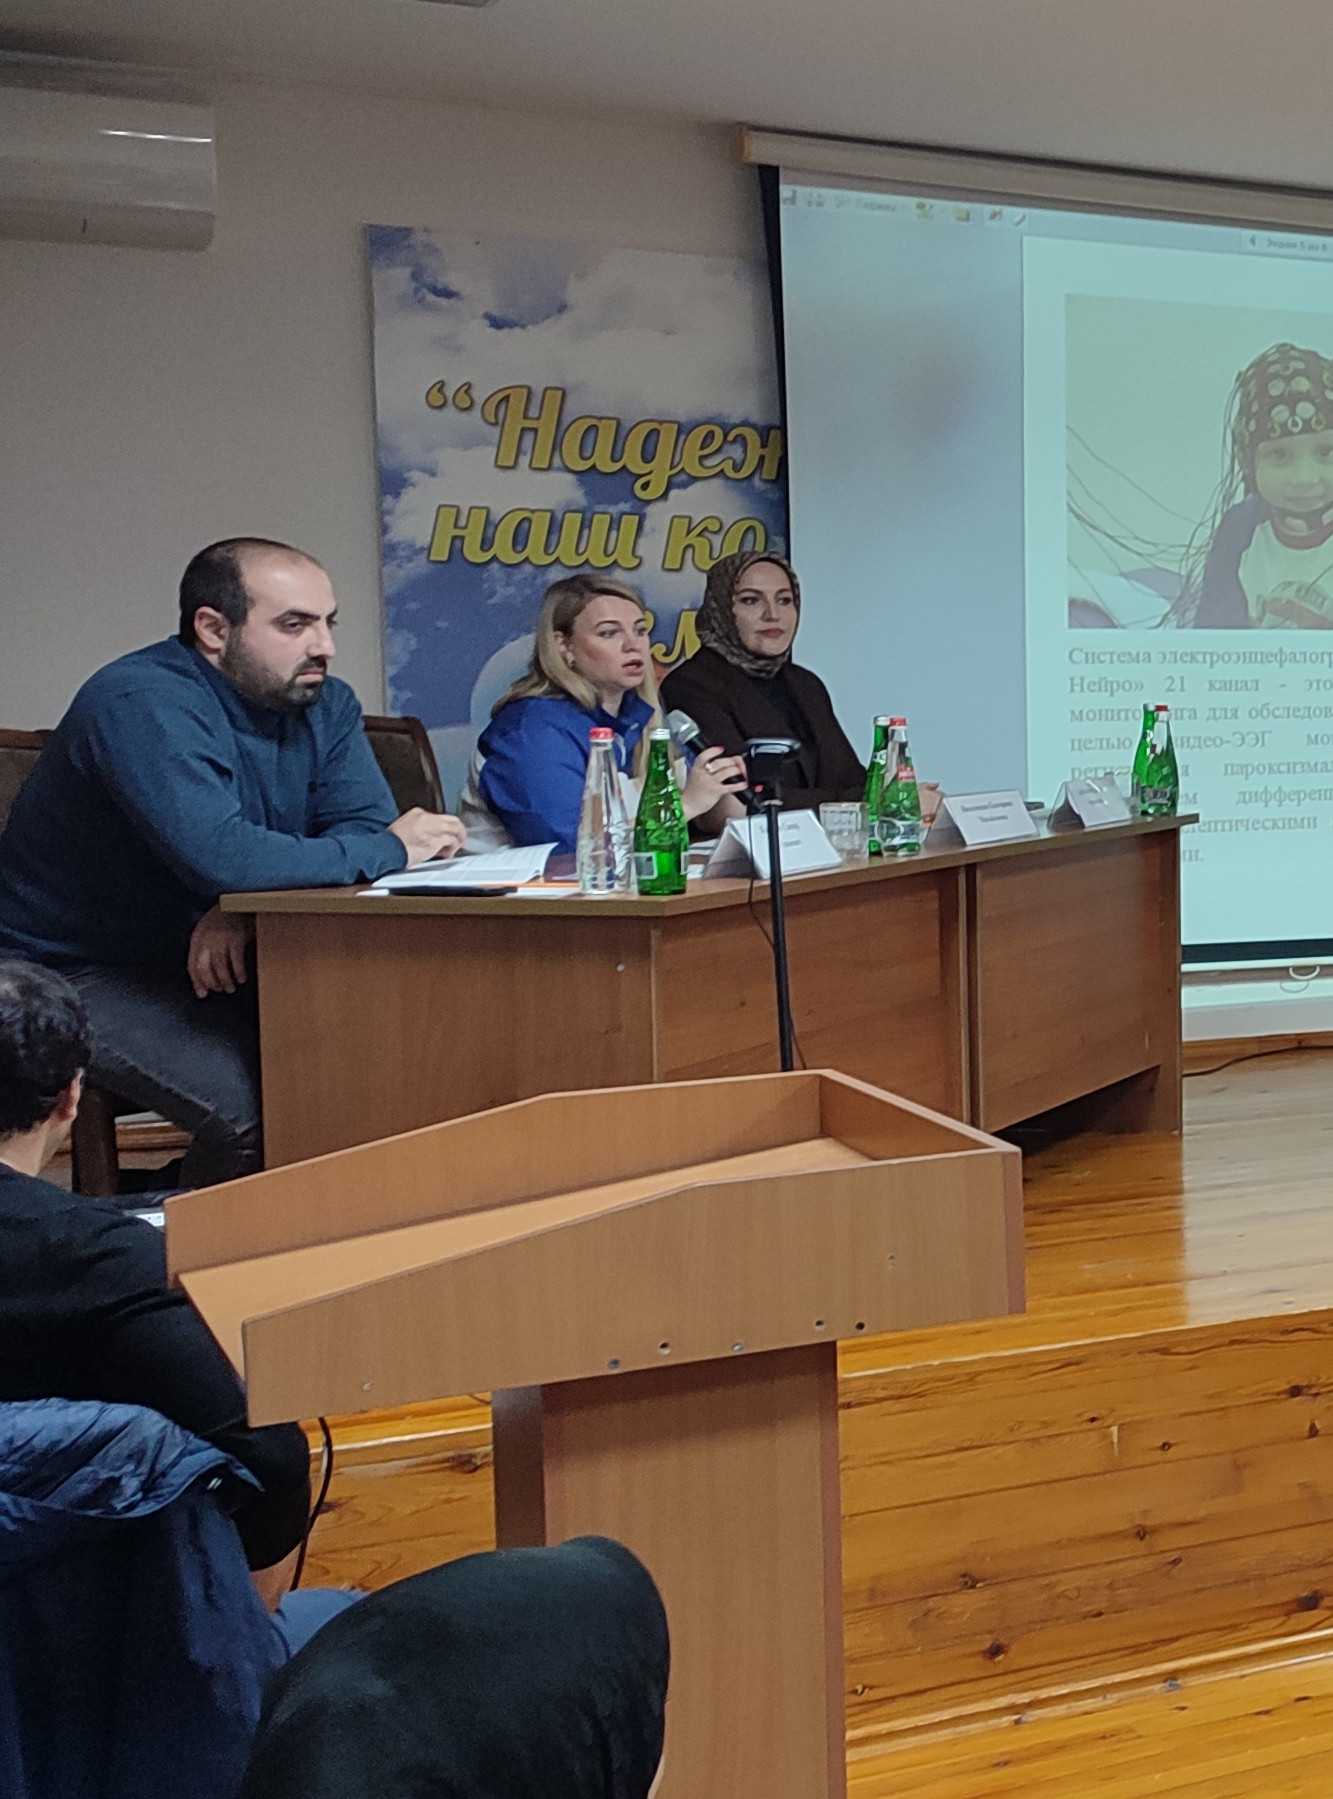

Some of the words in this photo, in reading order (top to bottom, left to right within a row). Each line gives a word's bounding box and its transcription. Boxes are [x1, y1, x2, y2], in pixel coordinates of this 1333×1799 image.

[427, 503, 642, 570] наш
[1068, 647, 1152, 665] Система
[1068, 675, 1144, 697] Нейро»
[1164, 675, 1186, 693] 21
[1207, 677, 1260, 692] канал
[1304, 677, 1333, 692] это
[1070, 707, 1198, 722] монитонга
[1206, 706, 1239, 722] для
[1070, 735, 1133, 751] целью
